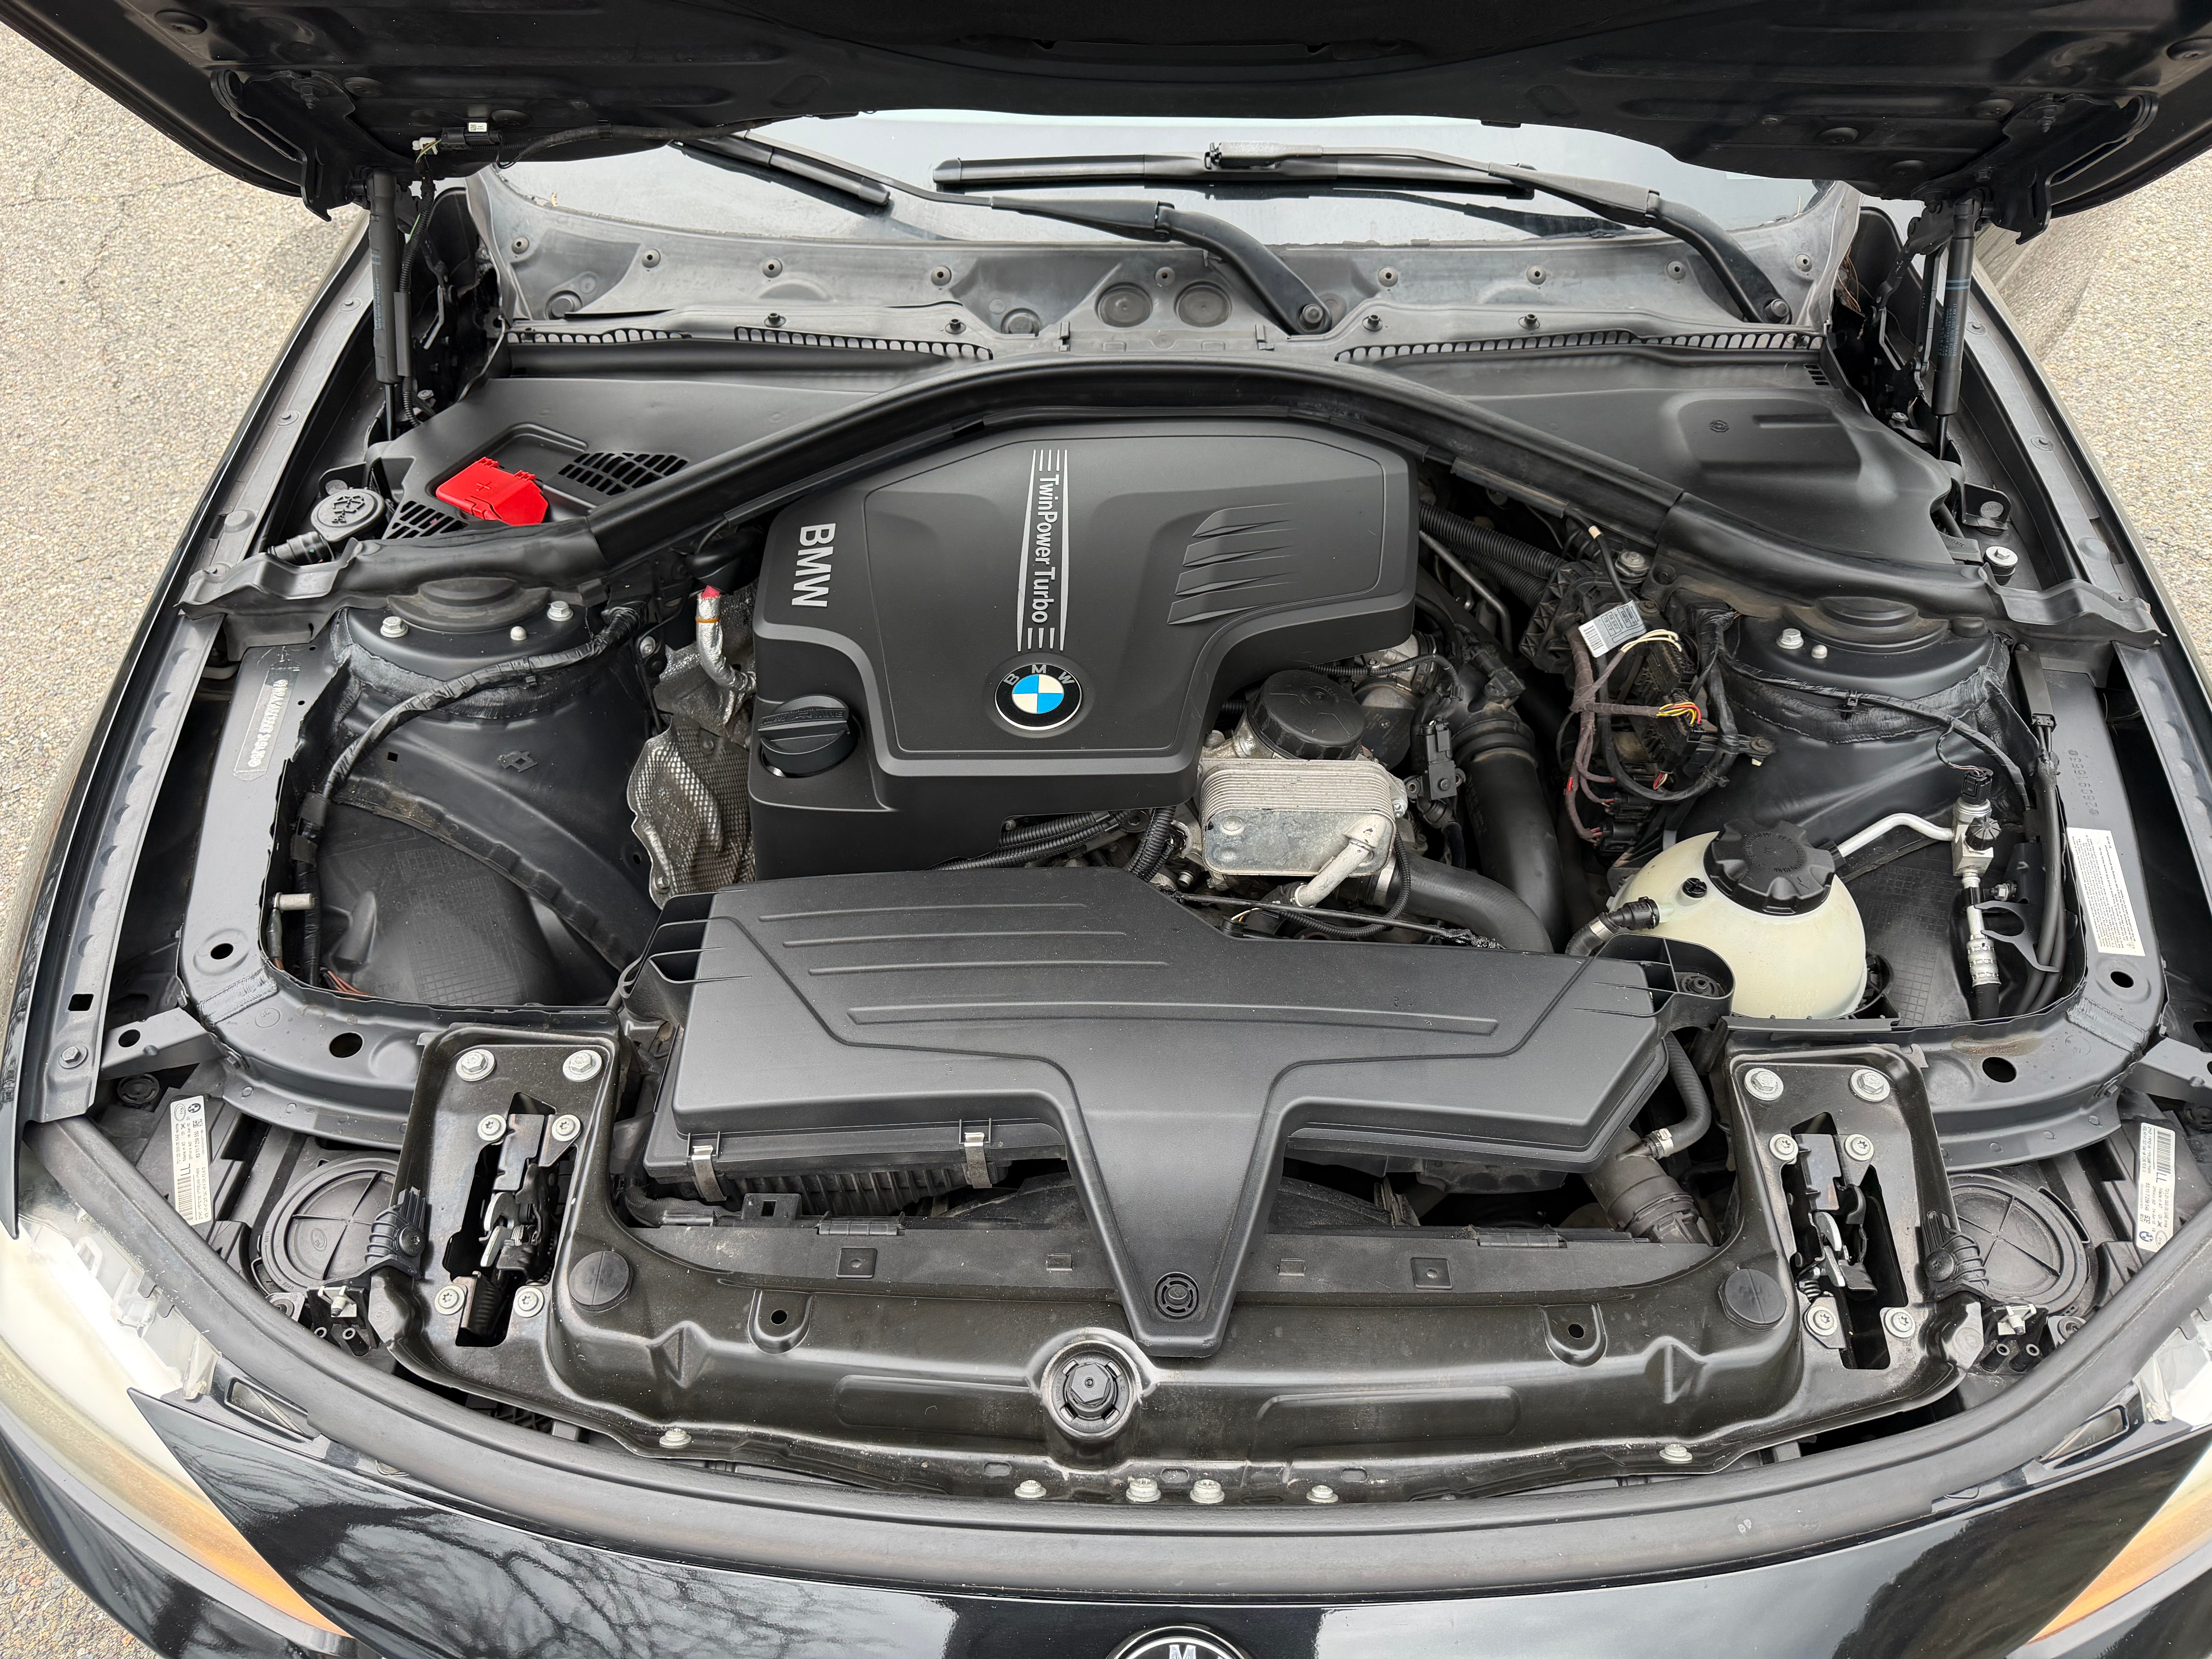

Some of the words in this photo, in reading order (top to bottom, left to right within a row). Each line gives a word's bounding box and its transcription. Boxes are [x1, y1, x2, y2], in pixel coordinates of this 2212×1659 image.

[1035, 474, 1060, 566] TwinPower
[791, 523, 836, 608] BMW
[1031, 566, 1057, 624] Turbo
[1003, 664, 1076, 686] BMW
[1780, 1002, 1816, 1018] MAX
[180, 1163, 191, 1176] LL
[2156, 1172, 2167, 1183] LL
